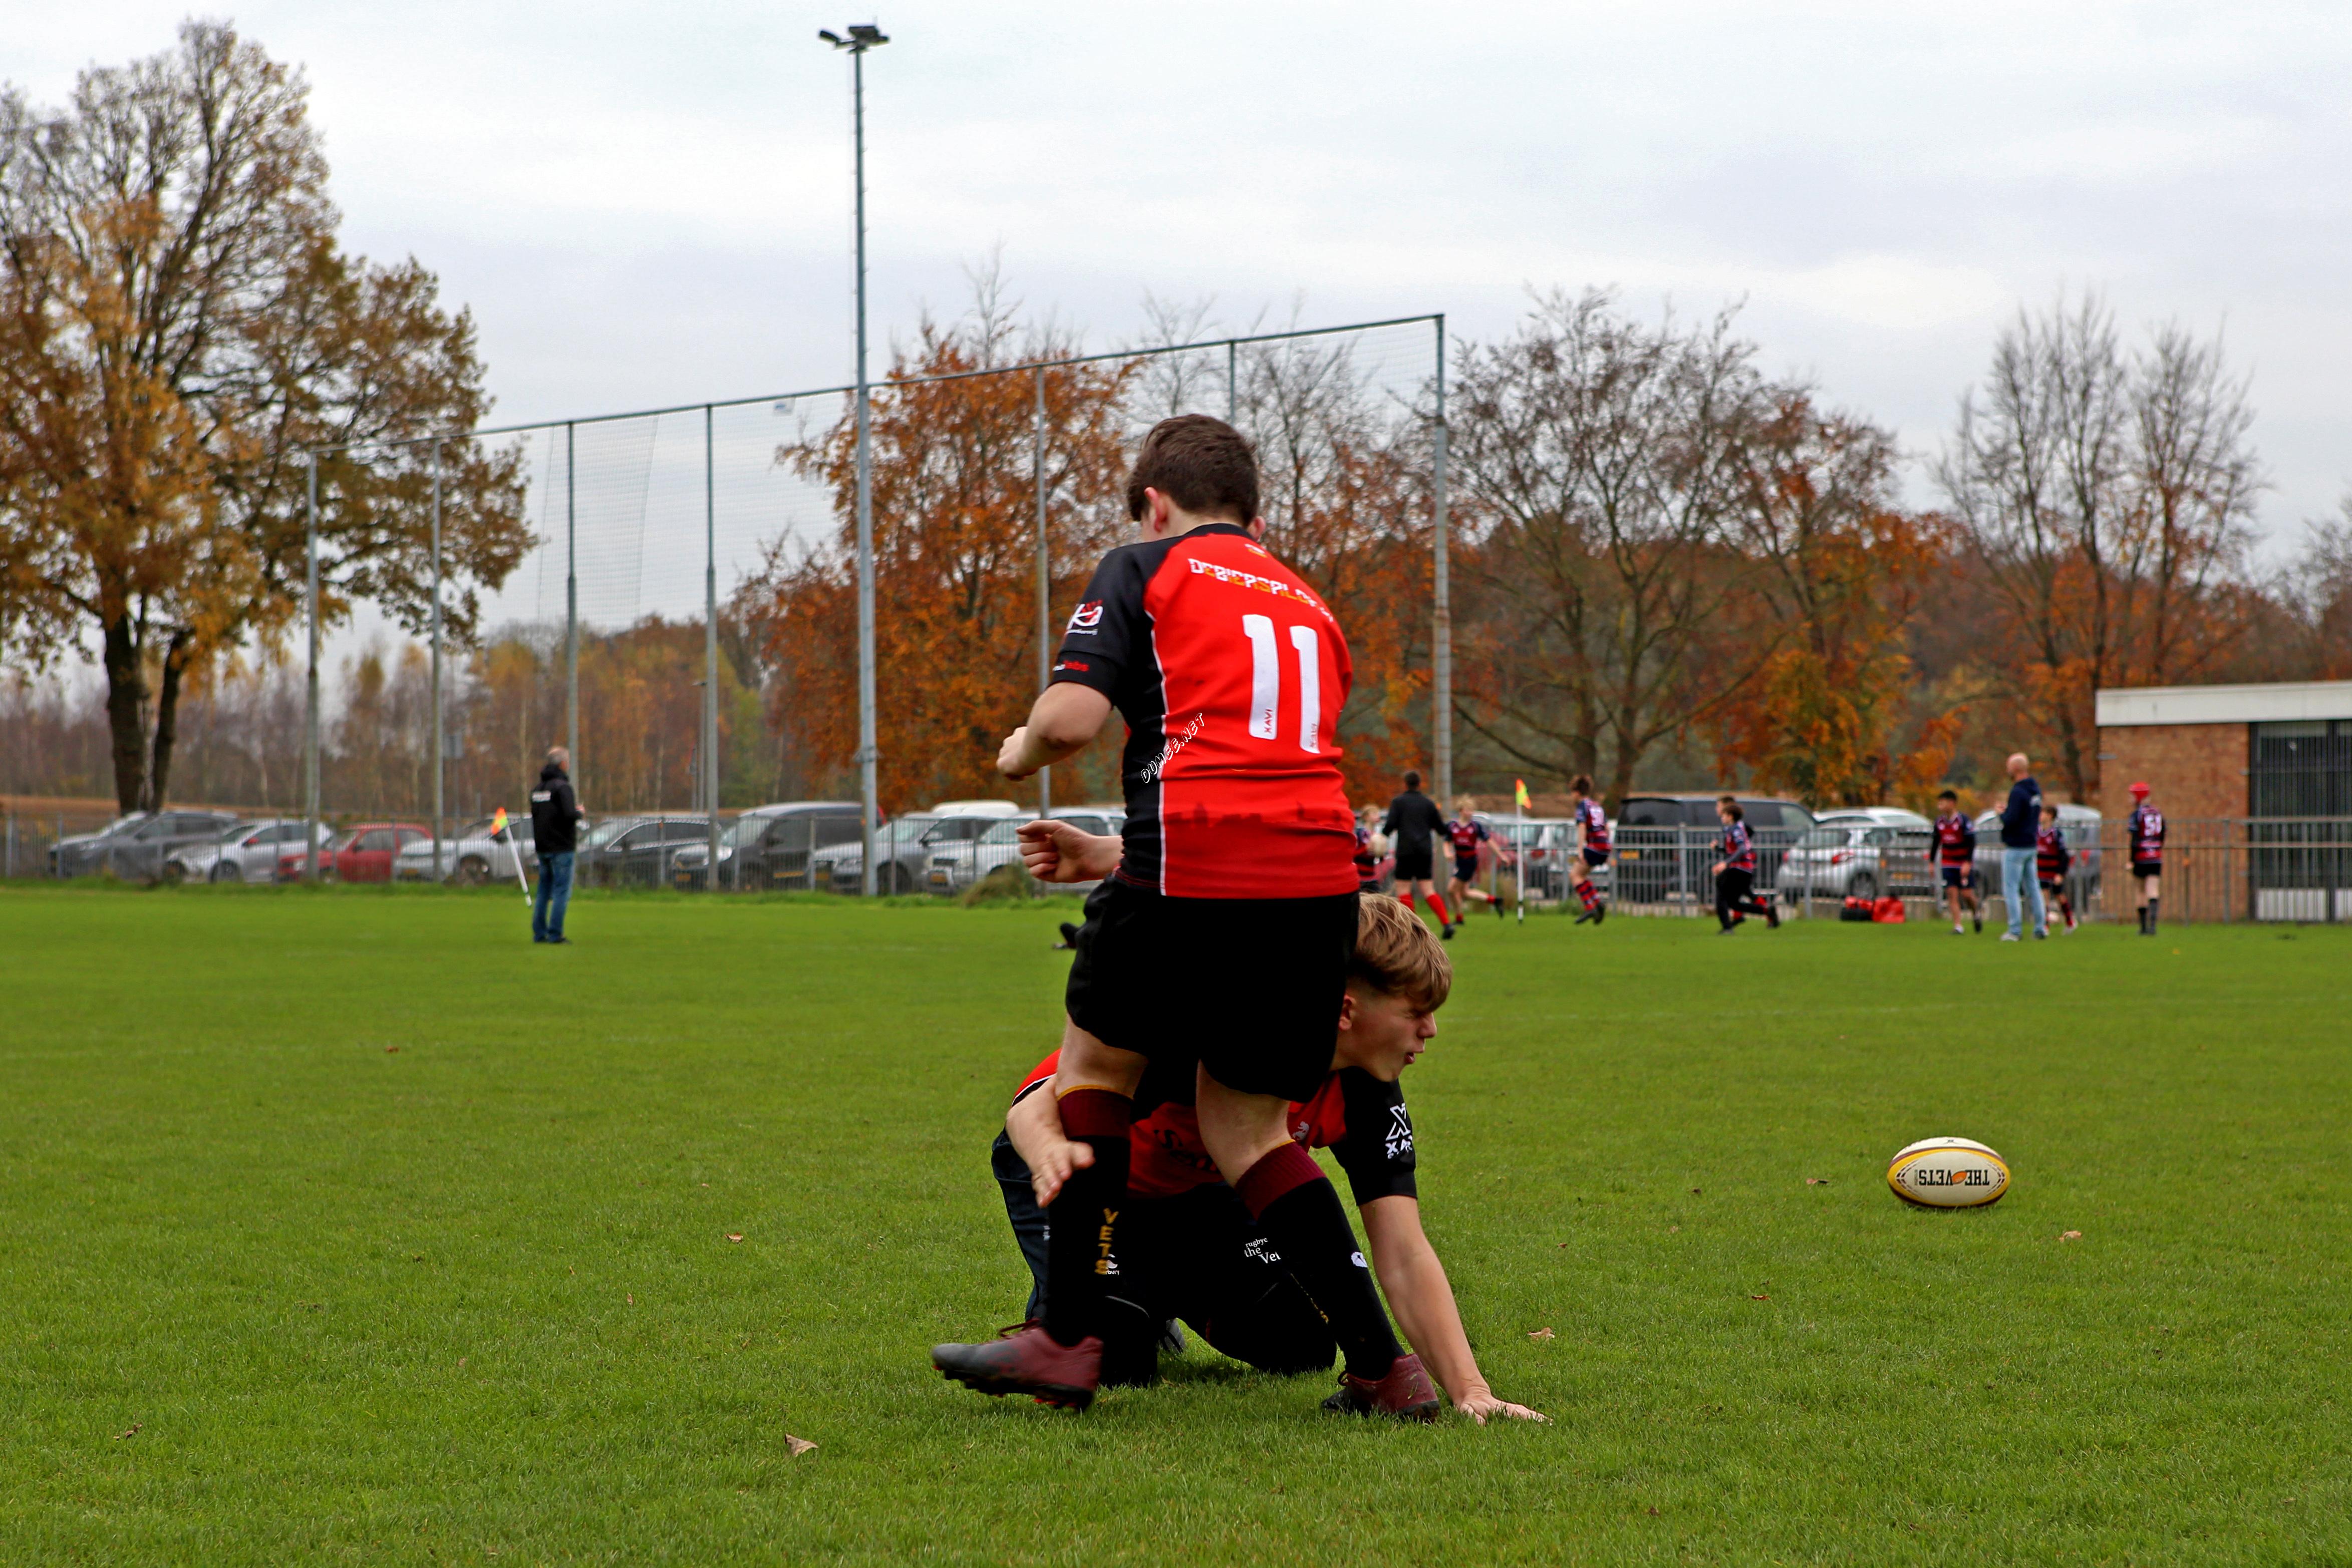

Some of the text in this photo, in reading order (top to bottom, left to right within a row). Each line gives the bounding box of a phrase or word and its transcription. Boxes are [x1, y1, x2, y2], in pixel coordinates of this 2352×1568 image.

[1242, 613, 1321, 754] 11
[1264, 708, 1273, 734] XAVI
[1918, 1169, 1953, 1186] VETS
[1964, 1169, 1990, 1186] THE
[1094, 1207, 1119, 1275] VETS
[1245, 1237, 1269, 1248] rugbyc
[1244, 1247, 1262, 1258] the
[1258, 1251, 1281, 1264] Vet
